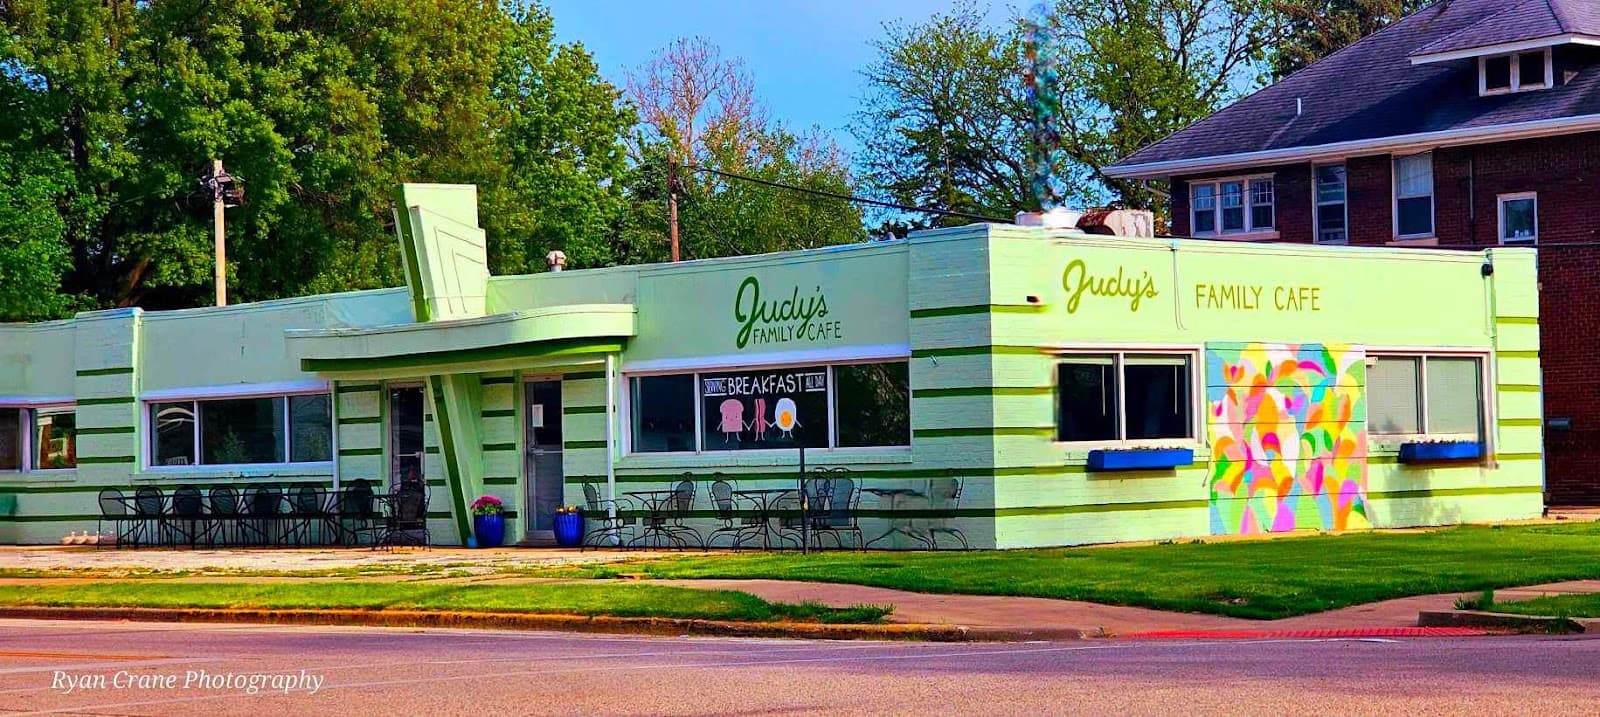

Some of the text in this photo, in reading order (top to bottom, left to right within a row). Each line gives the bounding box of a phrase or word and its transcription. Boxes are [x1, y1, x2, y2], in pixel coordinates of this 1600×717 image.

[1062, 259, 1160, 314] Judy's
[1195, 284, 1321, 311] FAMILY CAFE
[735, 276, 829, 349] Judy's
[753, 321, 842, 344] FAMILY CAFE
[728, 373, 804, 396] BREAKFAST
